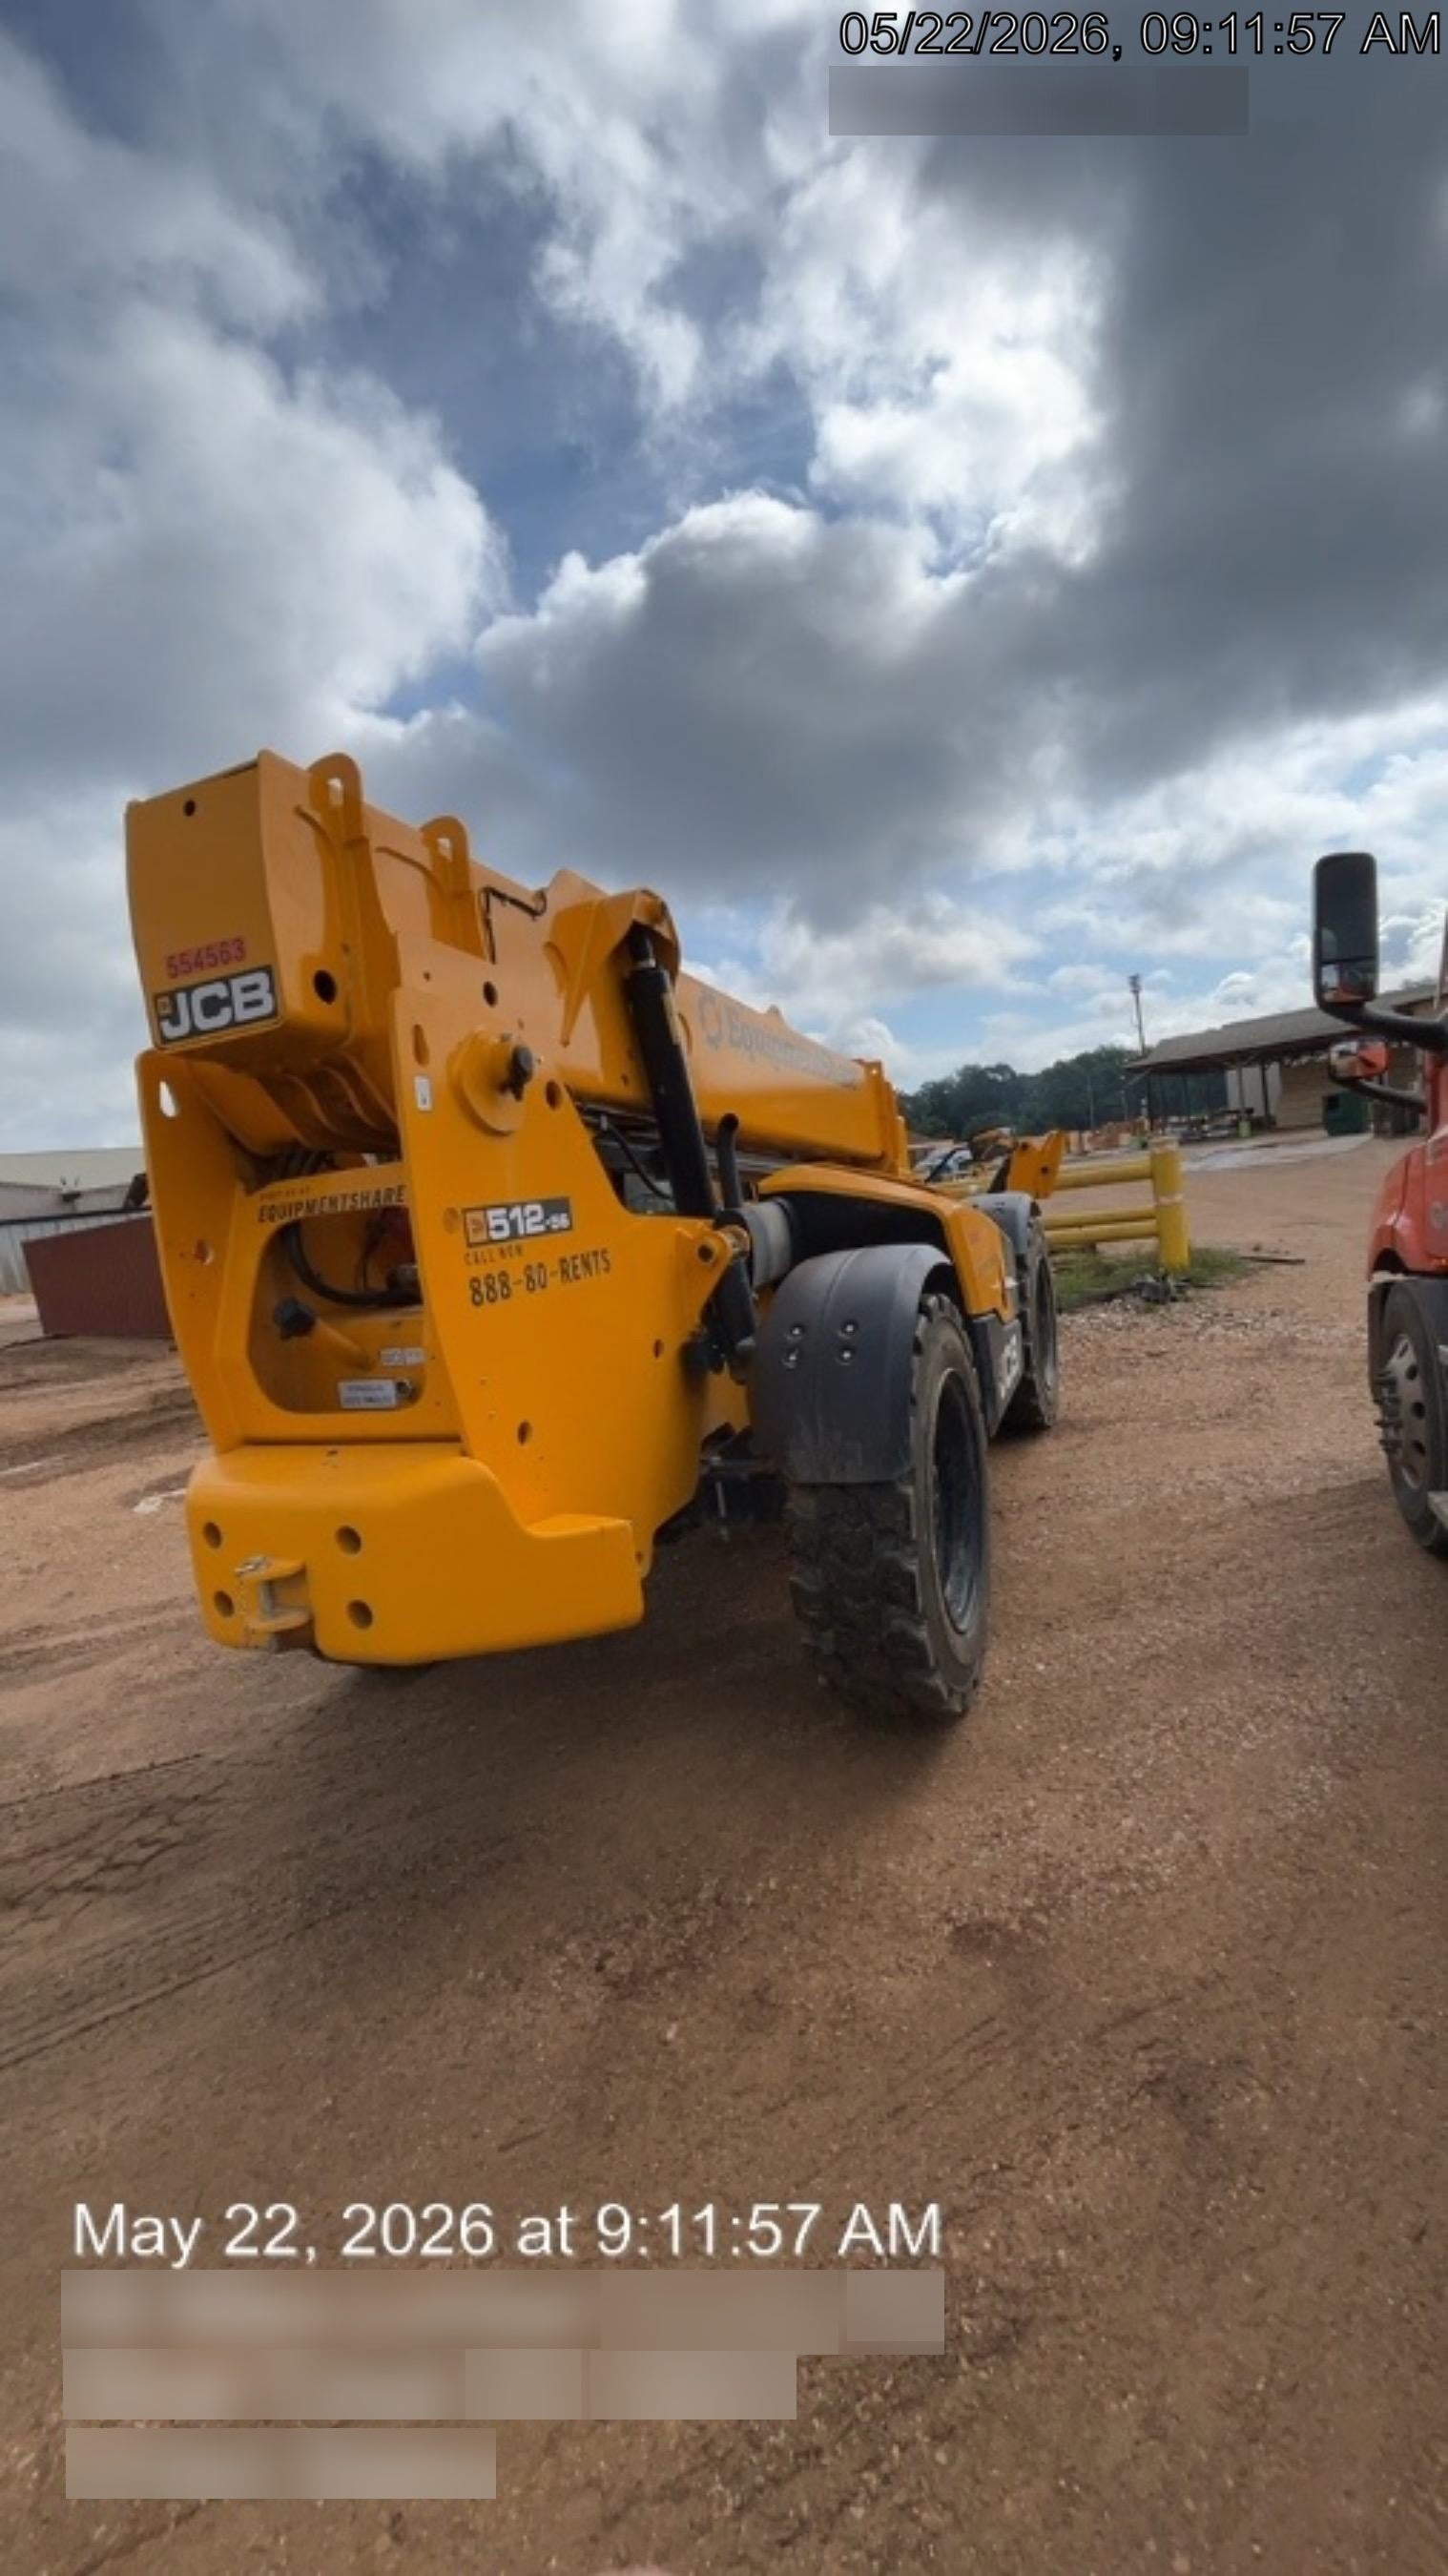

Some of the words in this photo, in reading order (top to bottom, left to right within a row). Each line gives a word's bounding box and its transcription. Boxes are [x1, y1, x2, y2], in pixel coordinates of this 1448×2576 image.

[166, 937, 246, 980] 554563
[160, 971, 274, 1040] JCB
[468, 1248, 611, 1307] 888-80-RENTS
